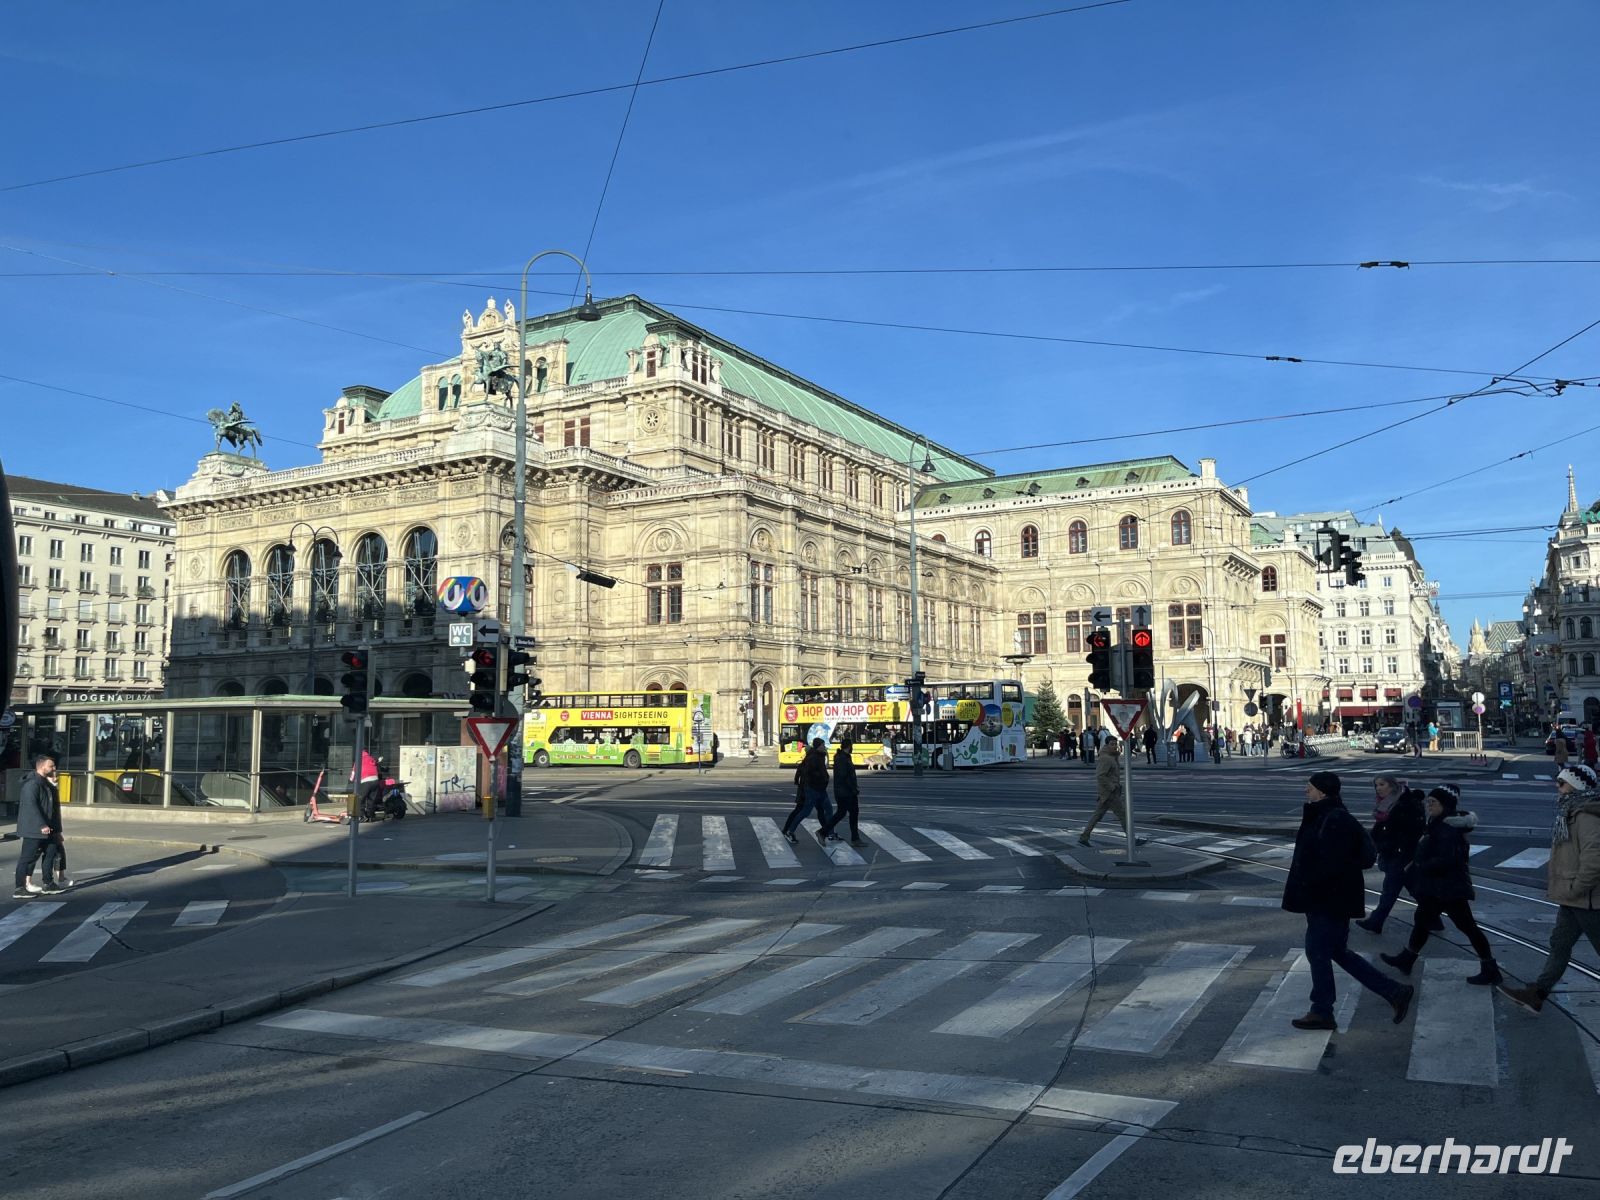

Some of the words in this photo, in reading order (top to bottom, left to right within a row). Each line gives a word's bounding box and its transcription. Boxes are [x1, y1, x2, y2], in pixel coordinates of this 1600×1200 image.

[444, 584, 461, 610] U
[470, 585, 485, 610] U
[452, 625, 471, 636] WC
[1500, 686, 1510, 695] P
[66, 693, 123, 702] BIOGENA
[582, 711, 612, 719] VIENNA
[614, 711, 668, 719] SIGHTSEEING
[802, 706, 823, 717] HOP
[824, 706, 839, 716] ON
[843, 705, 864, 716] HOP
[866, 704, 887, 715] OFF
